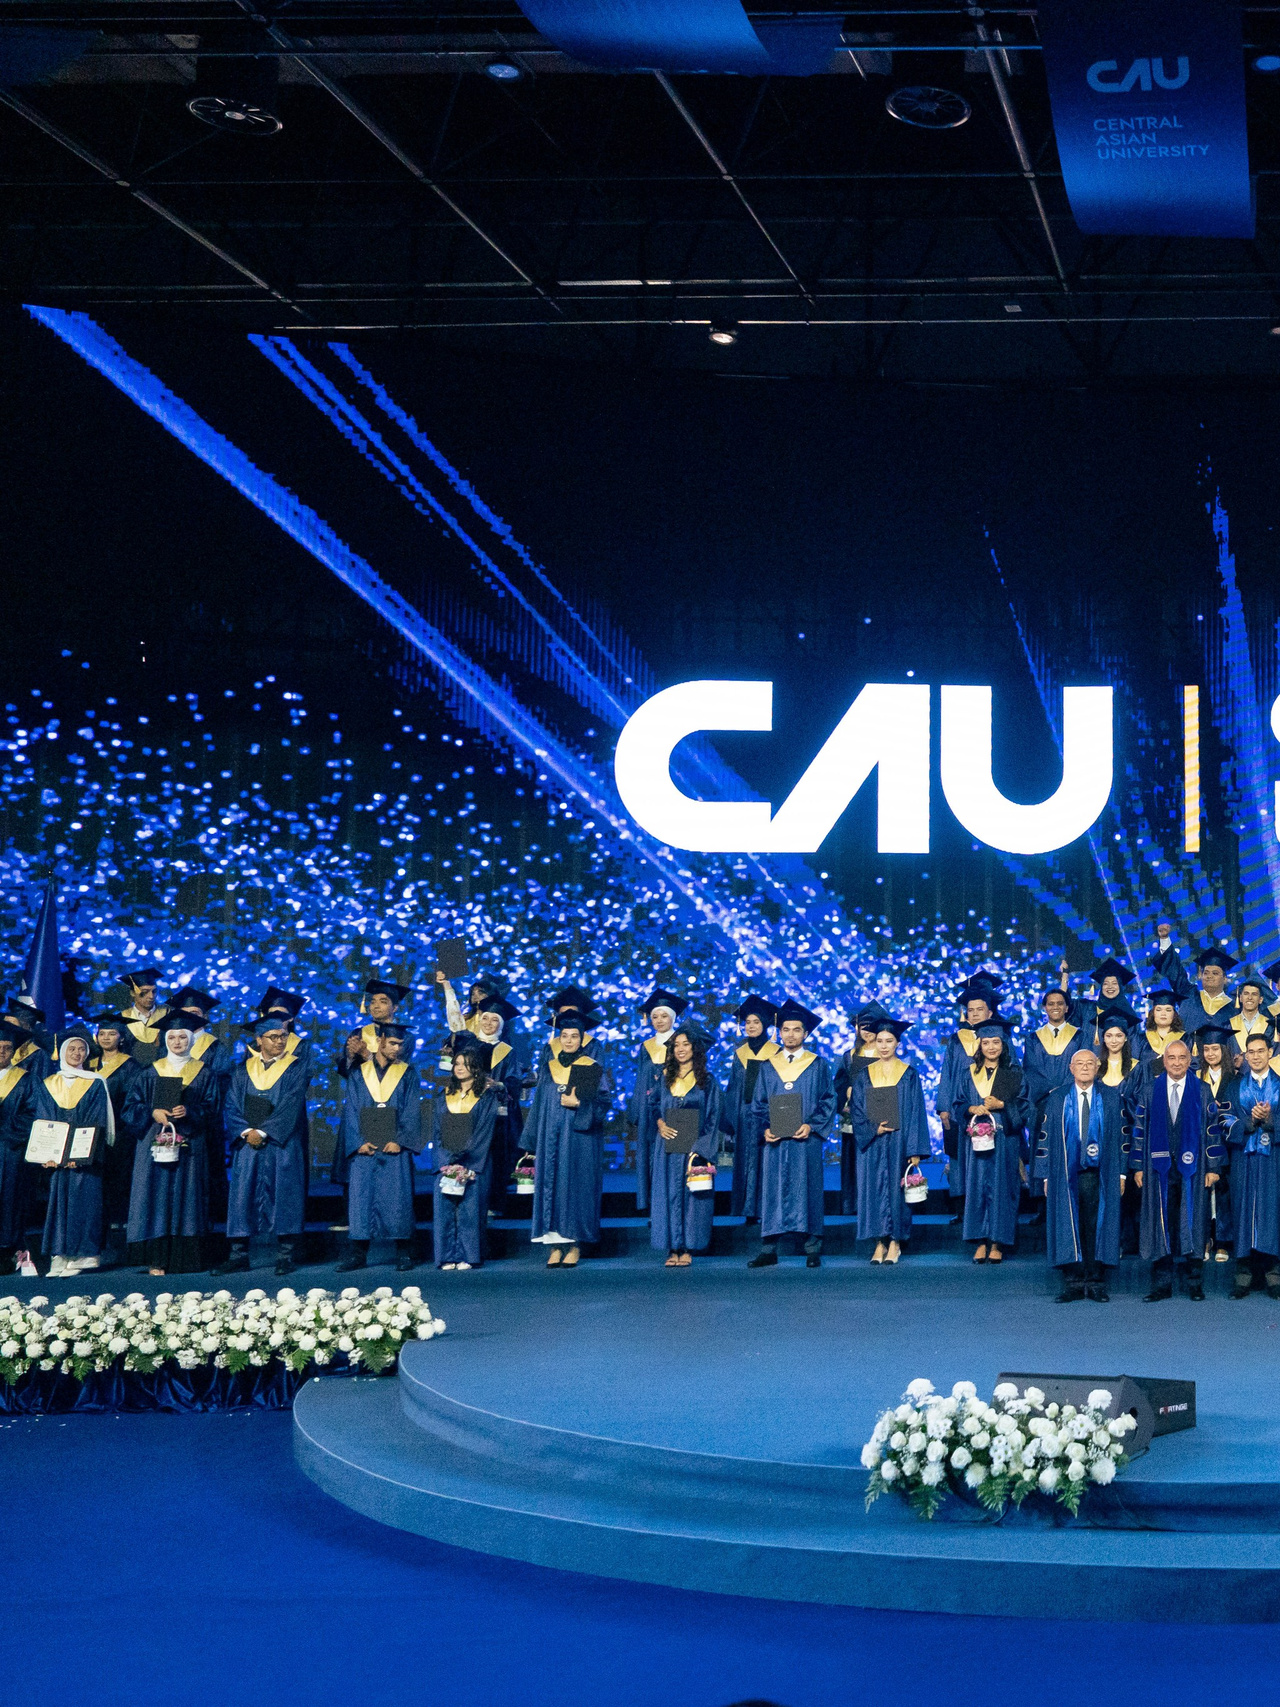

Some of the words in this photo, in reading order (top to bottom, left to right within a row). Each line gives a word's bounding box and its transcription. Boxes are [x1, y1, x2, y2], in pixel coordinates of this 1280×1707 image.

[1086, 56, 1190, 93] CAU
[1093, 115, 1183, 131] CENTRAL
[1096, 132, 1157, 146] ASIAN
[1097, 144, 1210, 160] UNIVERSITY
[614, 679, 1114, 855] CAU
